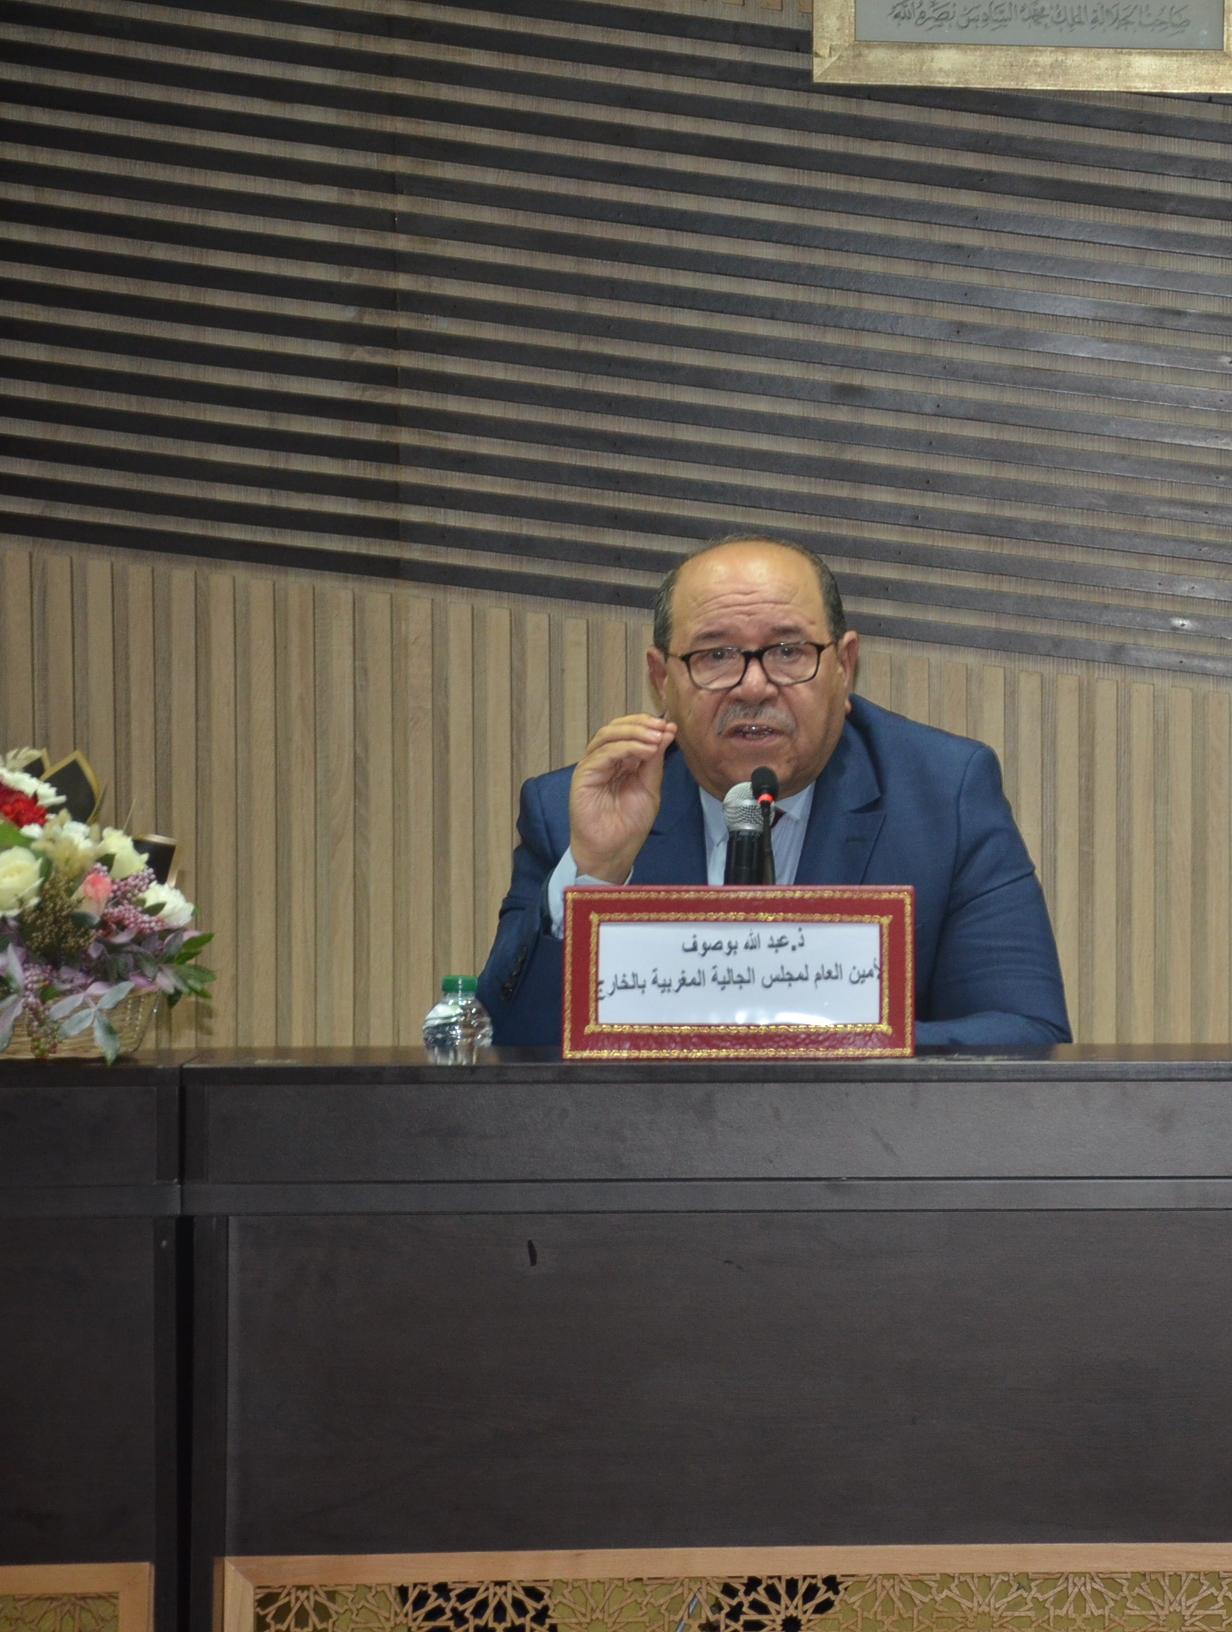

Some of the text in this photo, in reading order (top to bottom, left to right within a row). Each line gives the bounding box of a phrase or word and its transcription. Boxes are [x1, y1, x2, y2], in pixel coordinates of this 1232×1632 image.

[681, 934, 738, 957] بوصوف
[743, 930, 761, 951] الله
[651, 968, 706, 993] المغربية
[711, 965, 755, 991] الجالية
[761, 964, 809, 989] لمجلس
[813, 962, 843, 989] العام
